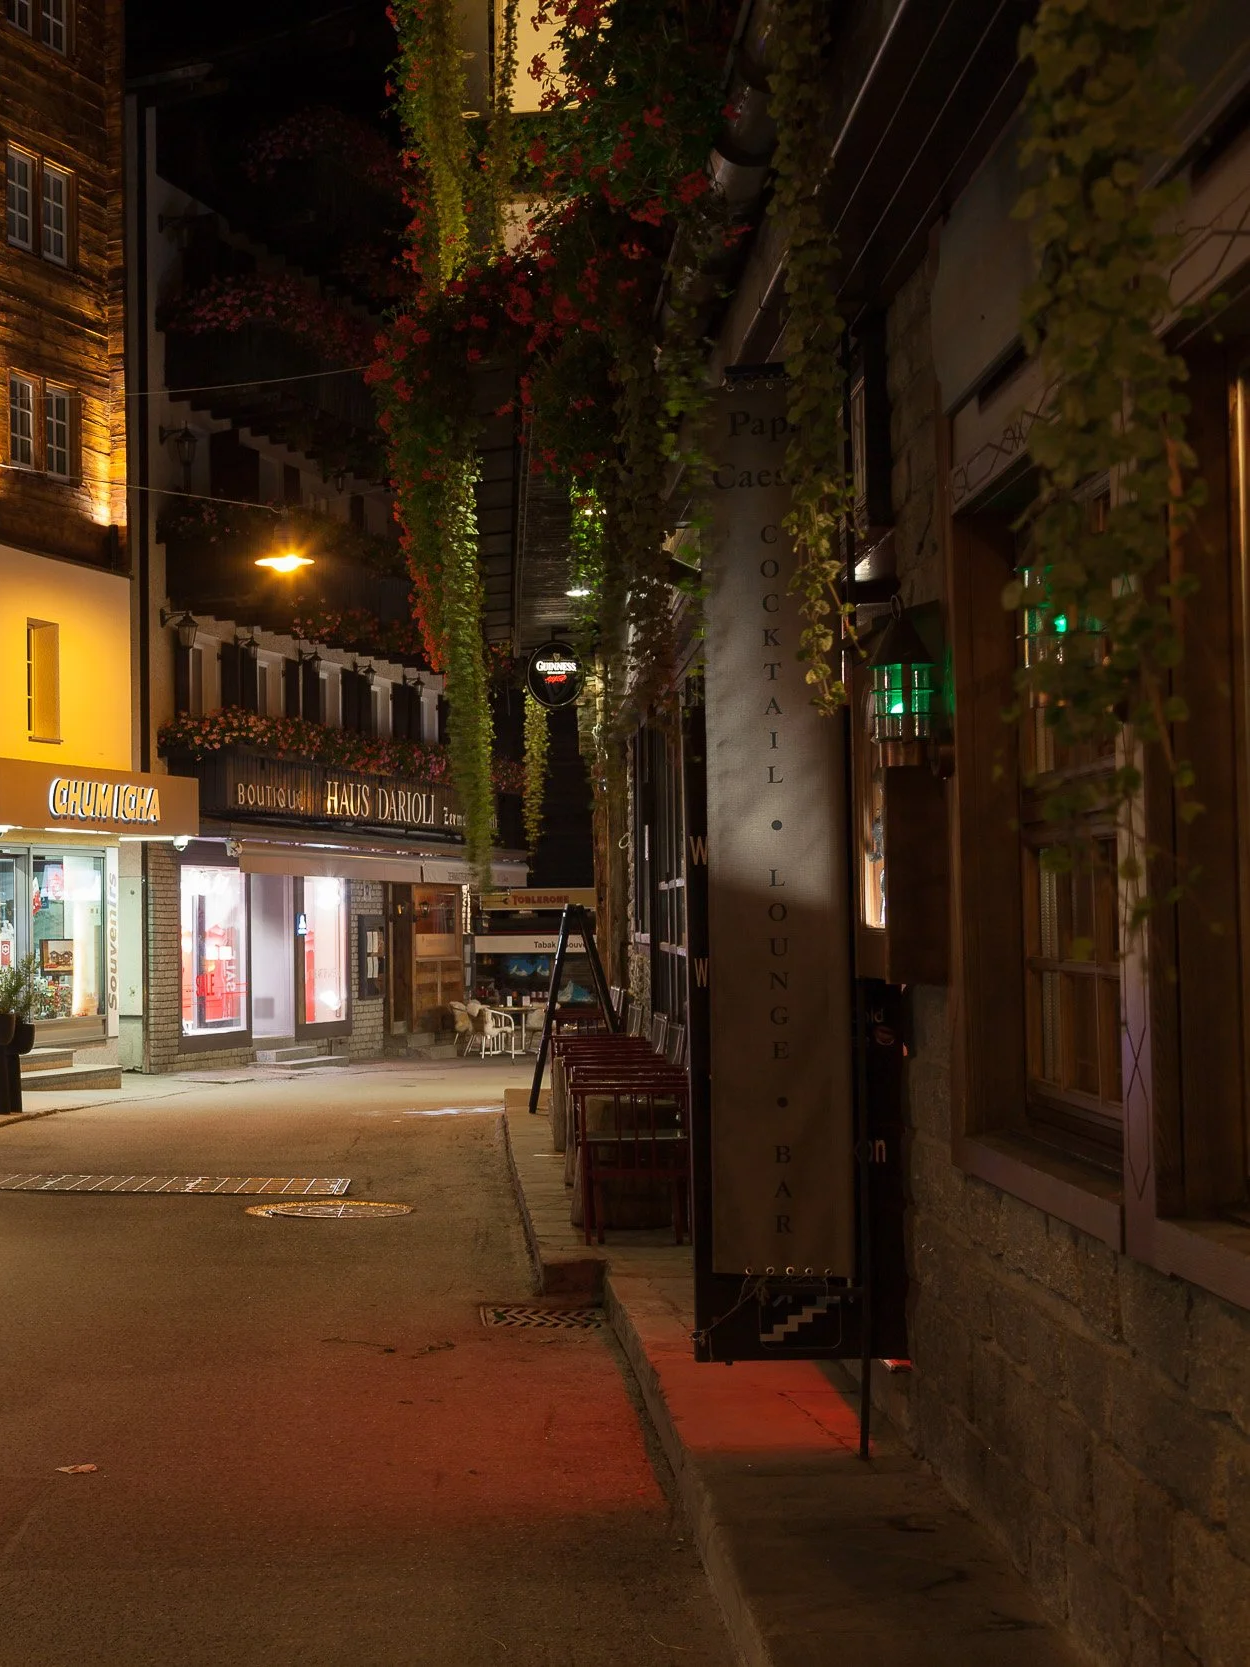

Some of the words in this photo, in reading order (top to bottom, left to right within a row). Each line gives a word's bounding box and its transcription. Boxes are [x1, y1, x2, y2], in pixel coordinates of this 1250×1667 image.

[726, 410, 801, 442] Pap
[535, 660, 577, 672] GUINNESS
[760, 524, 784, 785] COCKTAIL
[49, 777, 161, 823] CHUMICHA
[326, 780, 370, 818] HAUS
[378, 787, 435, 825] DARIOLI
[109, 872, 118, 1011] Souvenirs
[534, 941, 557, 949] Tabak
[768, 869, 790, 1060] LOUNGE
[773, 1144, 793, 1235] BAR
